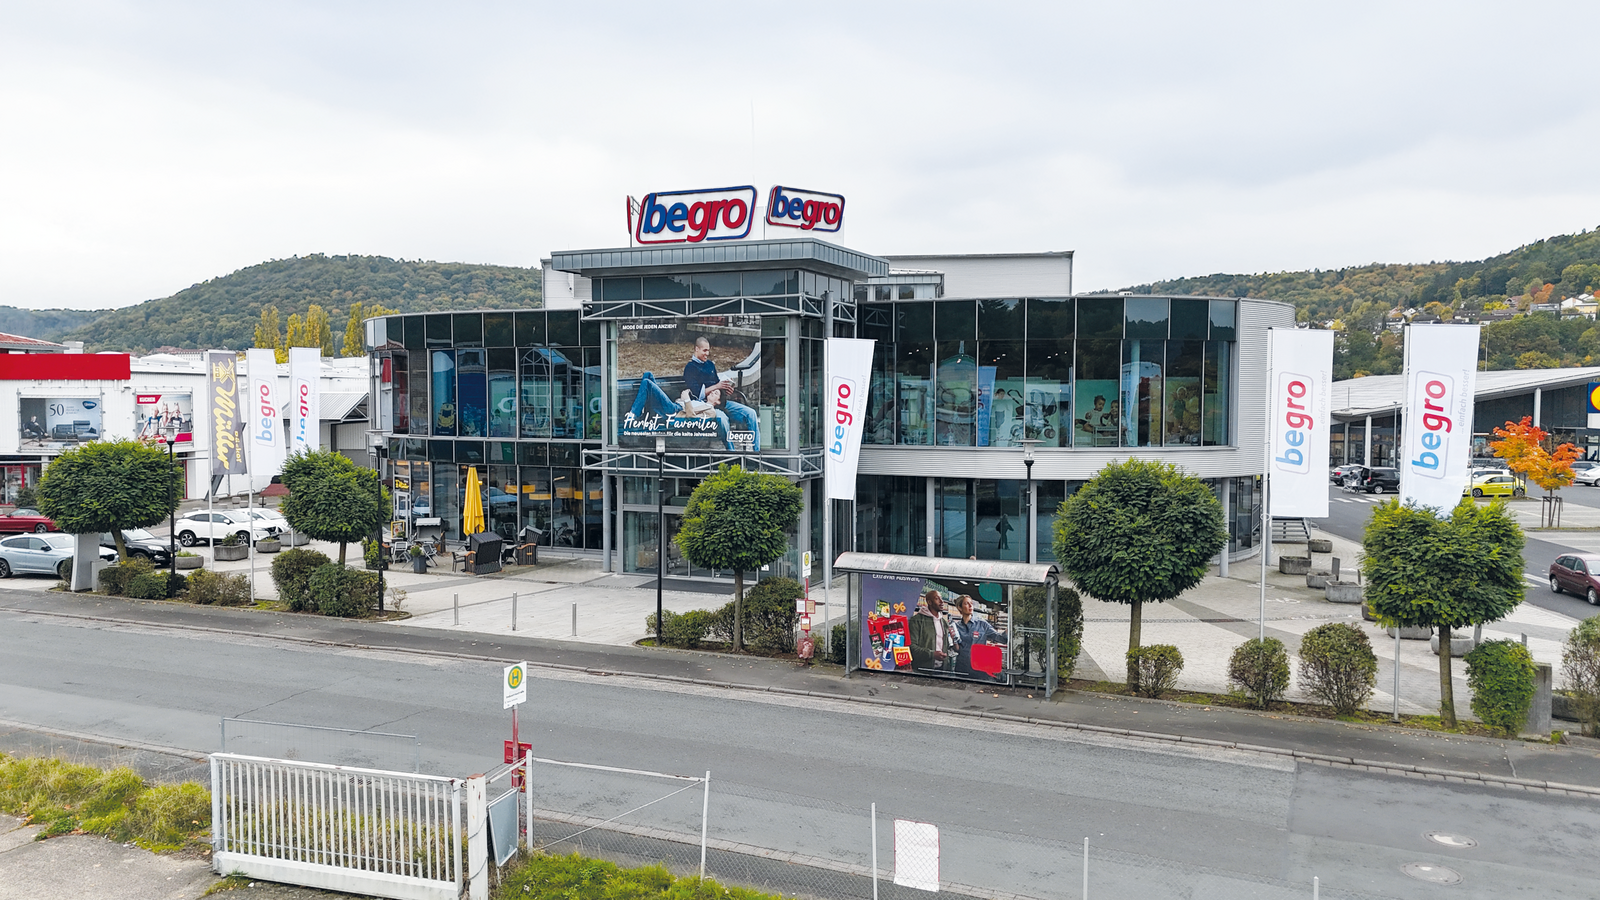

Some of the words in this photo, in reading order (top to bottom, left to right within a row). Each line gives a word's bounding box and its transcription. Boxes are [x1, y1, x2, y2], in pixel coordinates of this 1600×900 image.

[643, 193, 747, 242] begro
[771, 186, 841, 230] begro
[49, 403, 65, 416] 50
[213, 377, 236, 470] Müller
[255, 384, 276, 442] begro
[623, 412, 719, 431] Herbst-Favoriten
[829, 383, 853, 456] begro
[1275, 380, 1314, 466] begro
[1411, 380, 1453, 471] begro
[729, 431, 753, 443] begro
[512, 671, 519, 684] H
